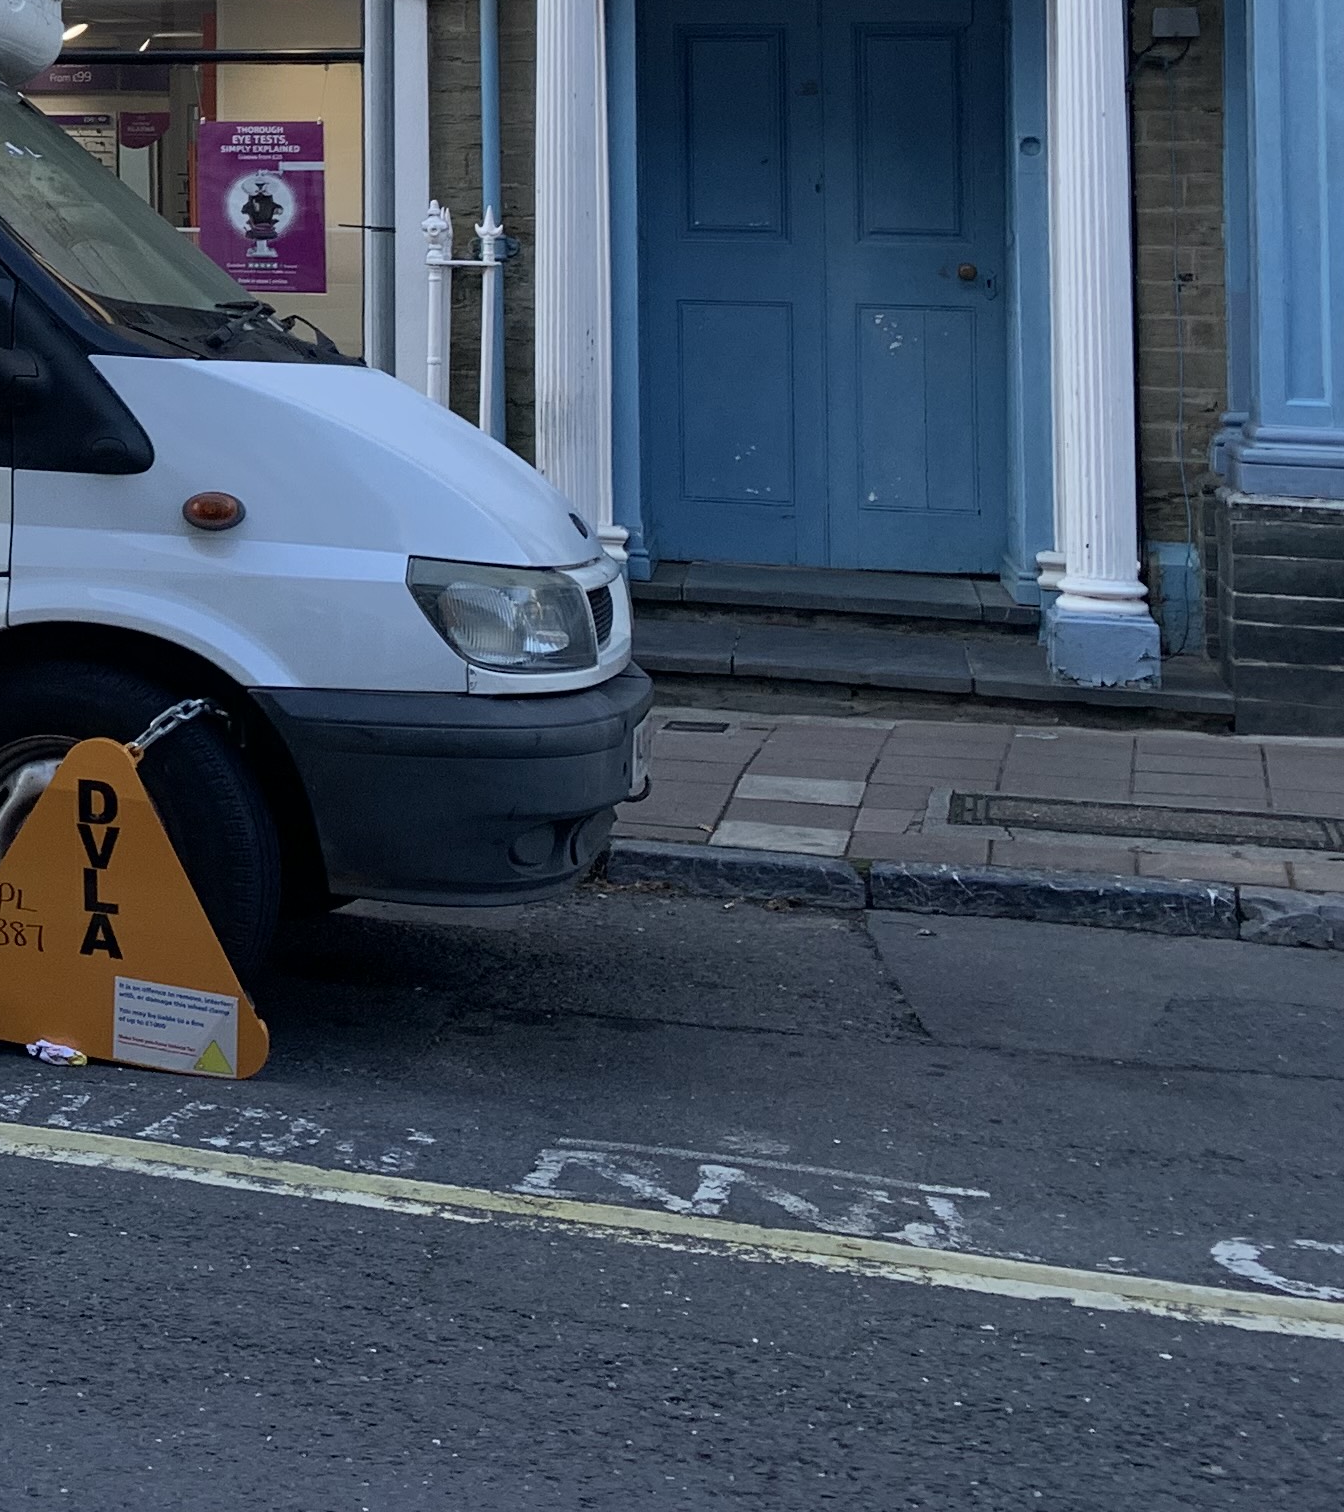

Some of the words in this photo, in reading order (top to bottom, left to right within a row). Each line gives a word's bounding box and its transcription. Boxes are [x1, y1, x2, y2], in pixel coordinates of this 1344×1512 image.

[236, 126, 284, 134] THOROUGH
[232, 135, 251, 144] EYE
[220, 145, 251, 153] SIMPLY
[252, 145, 300, 153] EXPLAINED
[77, 779, 123, 960] DVLA
